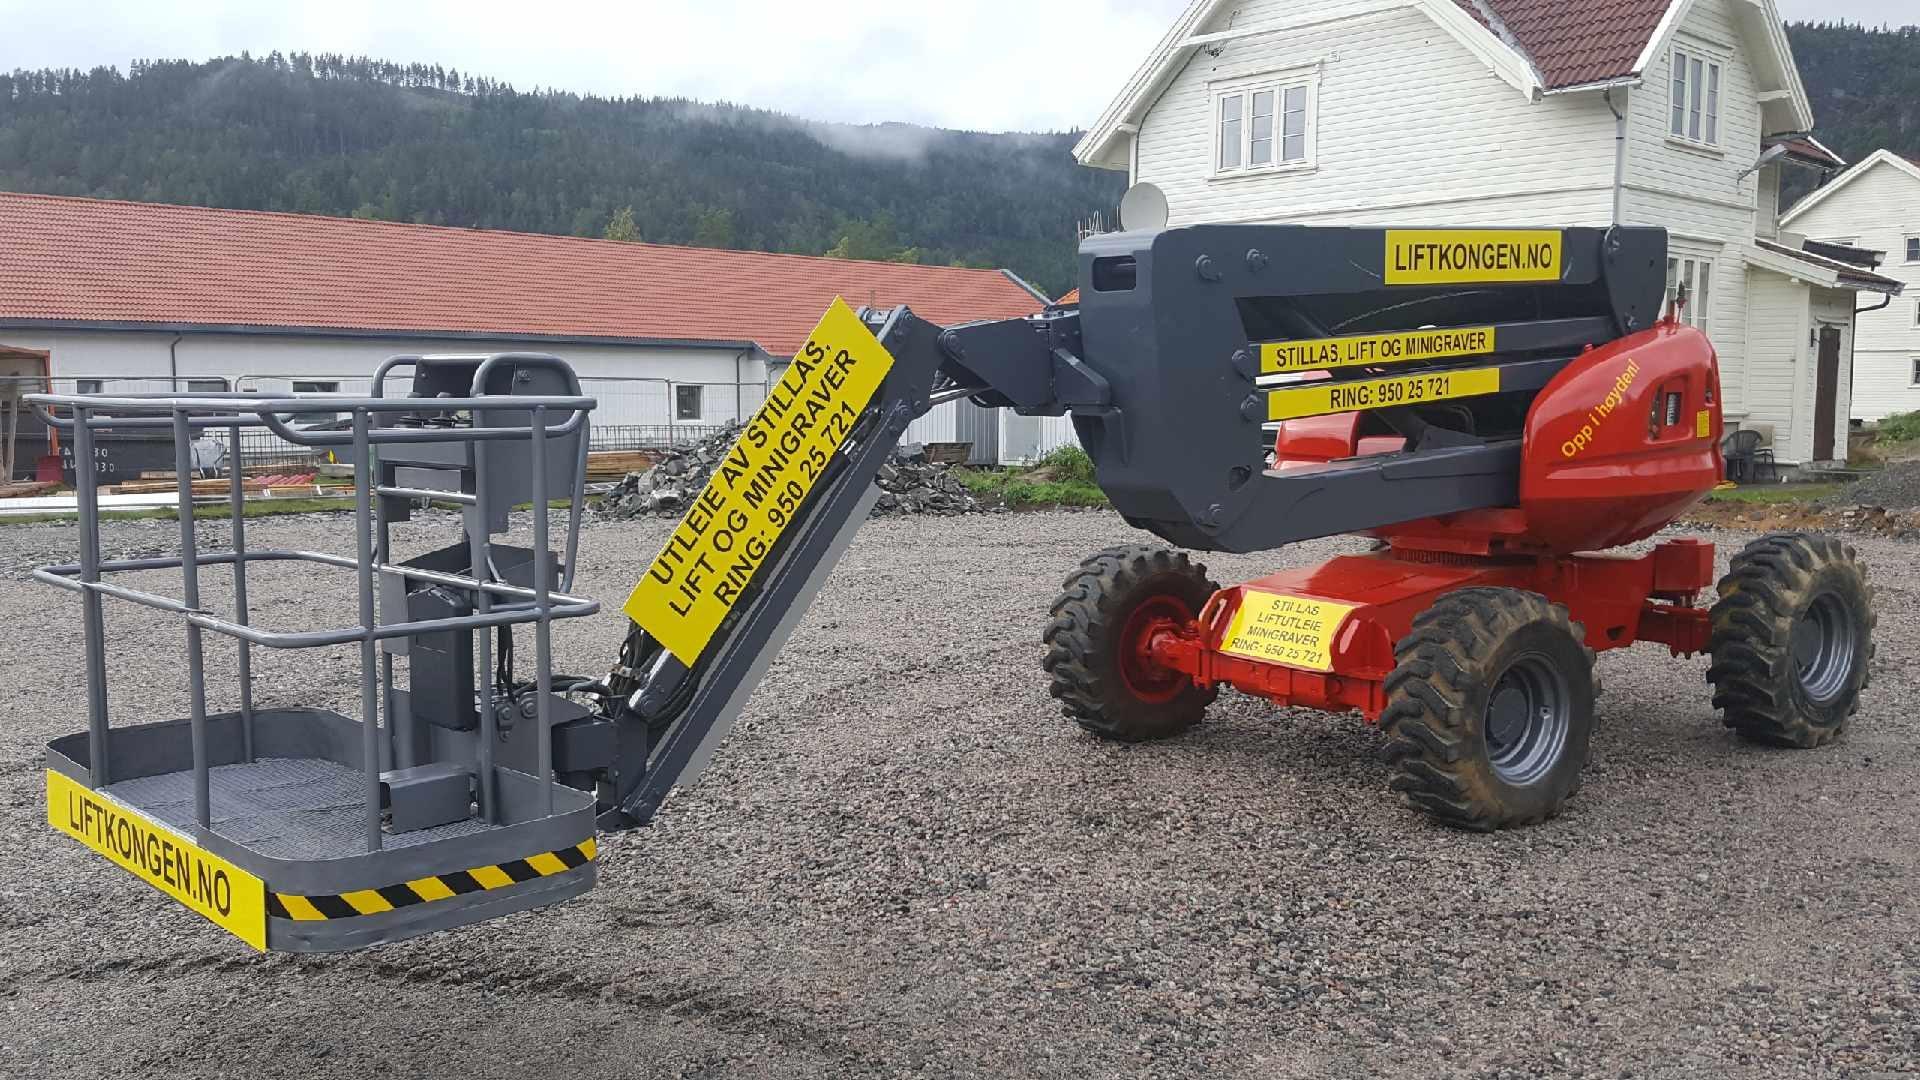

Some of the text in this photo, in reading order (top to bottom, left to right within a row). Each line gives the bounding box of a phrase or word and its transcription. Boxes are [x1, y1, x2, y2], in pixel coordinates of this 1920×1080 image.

[1395, 243, 1552, 271] LIFTKONGEN.NO
[1276, 331, 1486, 367] STILLAS, LIFT OG MINIGRAVER
[1330, 376, 1450, 409] RING: 950 25 721
[1561, 424, 1593, 458] Opp
[1588, 413, 1601, 427] i
[668, 349, 858, 618] LIFT OG MINIGRAVER
[650, 484, 727, 585] UTLEIE
[721, 445, 751, 490] AV
[713, 400, 857, 607] RING: 950 25 721
[1257, 612, 1323, 632] LIFTUTLEIE
[1271, 599, 1320, 616] STILLAS
[1246, 625, 1320, 648] MINIGRAVER
[1264, 643, 1284, 656] 950
[1286, 647, 1301, 660] 25
[1304, 649, 1323, 664] 721
[69, 790, 231, 918] LIFTKONGEN.NO
